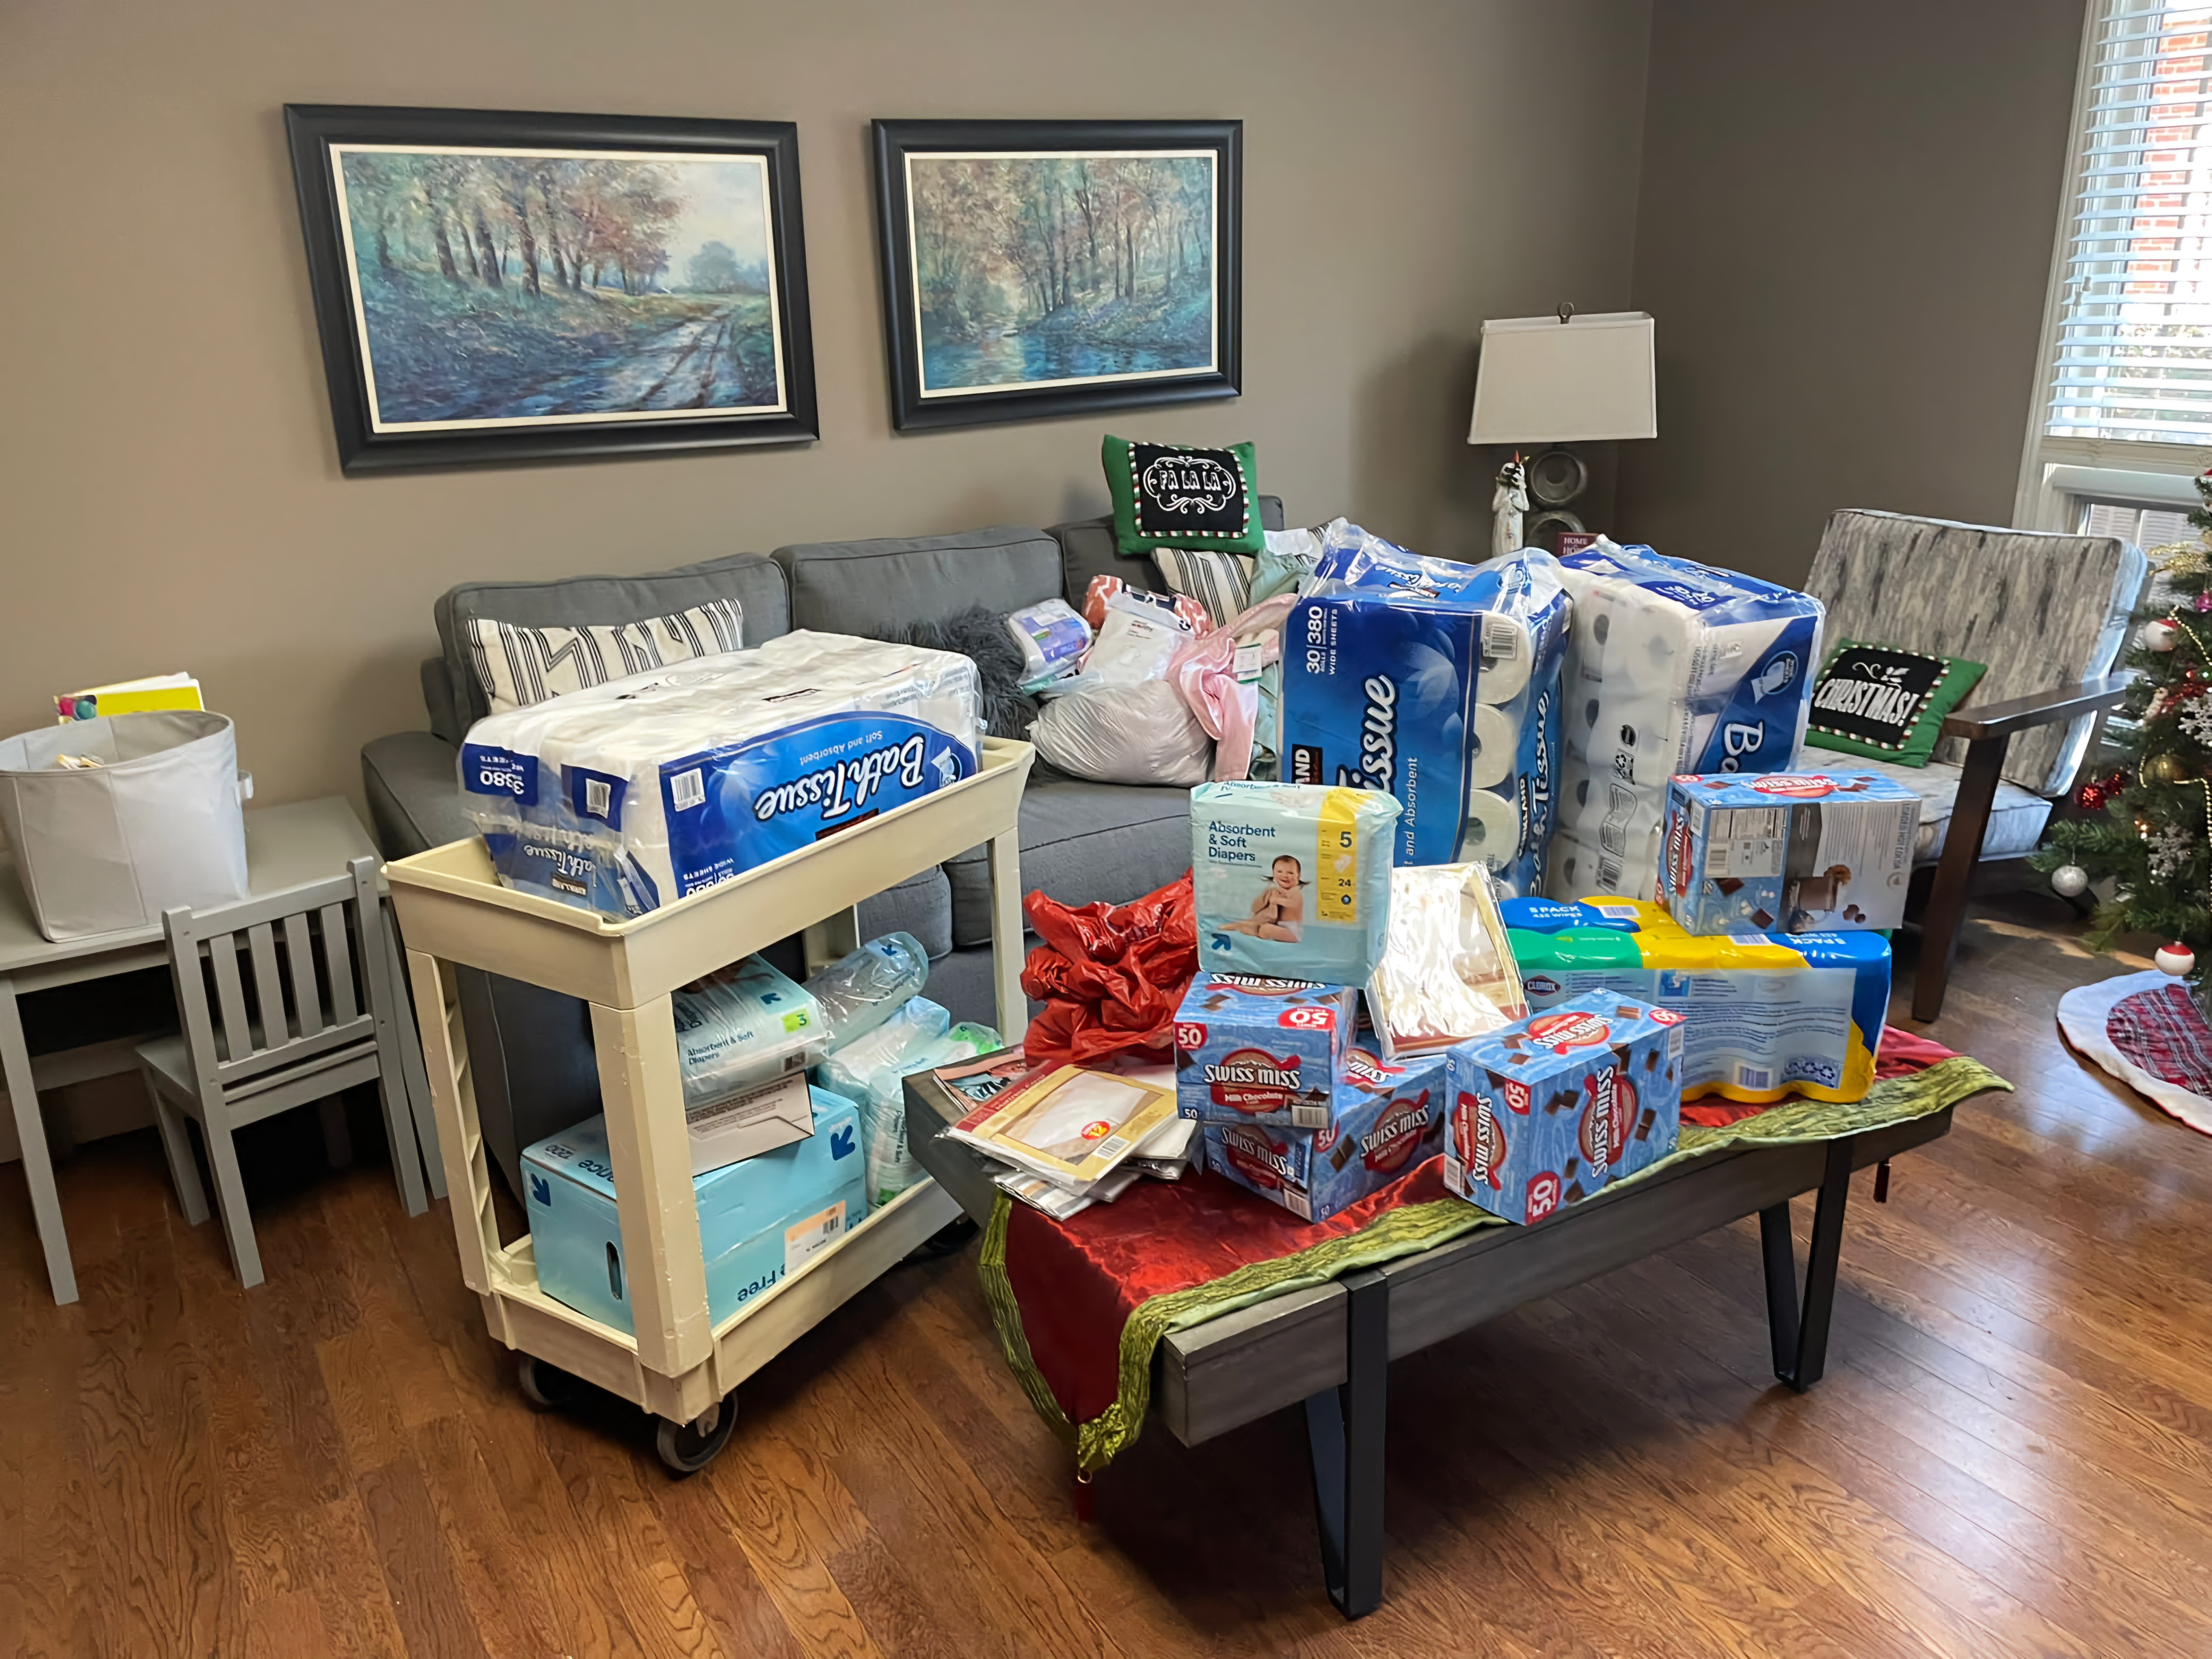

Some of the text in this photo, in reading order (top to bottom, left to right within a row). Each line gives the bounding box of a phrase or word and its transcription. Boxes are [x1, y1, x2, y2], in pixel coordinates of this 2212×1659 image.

[1181, 470, 1201, 490] LA
[1202, 471, 1222, 491] LA
[1564, 536, 1589, 545] HOME
[1306, 606, 1323, 675] 30 380
[1814, 678, 1920, 727] CHRISTMAS!
[799, 730, 883, 766] Soft and Absorbent
[754, 736, 925, 820] Bath Tissue
[1405, 756, 1418, 827] Absorbent
[1209, 820, 1276, 838] Absorbent
[1209, 834, 1246, 848] & Soft
[1339, 831, 1352, 848] 5
[1406, 831, 1415, 856] and
[1209, 846, 1256, 862] Diapers
[1339, 878, 1351, 887] 24
[797, 1014, 807, 1026] 3
[1289, 1011, 1330, 1025] 50
[1178, 1028, 1202, 1046] 50
[1509, 1082, 1525, 1109] 50
[1184, 1109, 1198, 1118] 50
[1532, 1179, 1553, 1217] 50
[737, 1270, 776, 1302] Free
